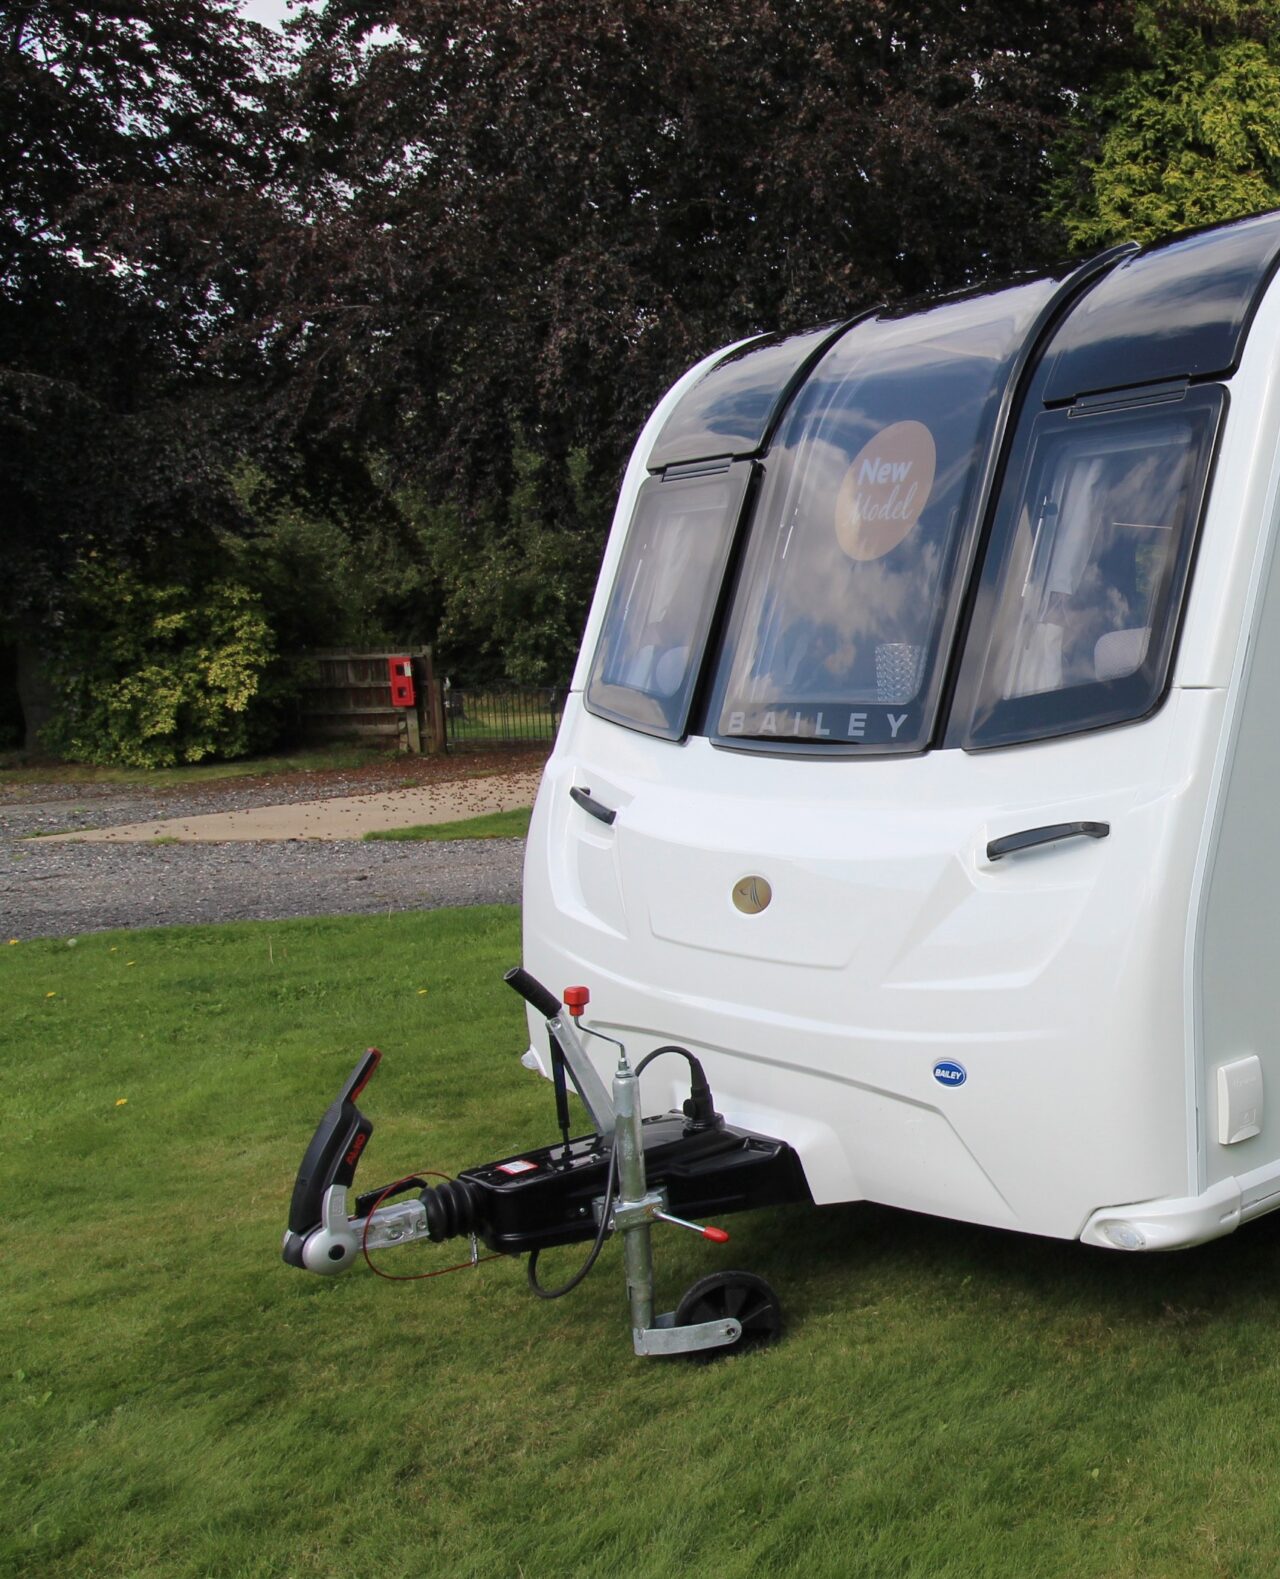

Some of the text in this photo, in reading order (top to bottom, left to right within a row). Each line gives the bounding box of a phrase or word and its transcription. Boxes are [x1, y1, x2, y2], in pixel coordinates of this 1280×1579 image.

[857, 457, 913, 485] New
[842, 481, 918, 526] Model
[727, 711, 909, 738] BAILEY
[935, 1068, 962, 1080] BAILEY
